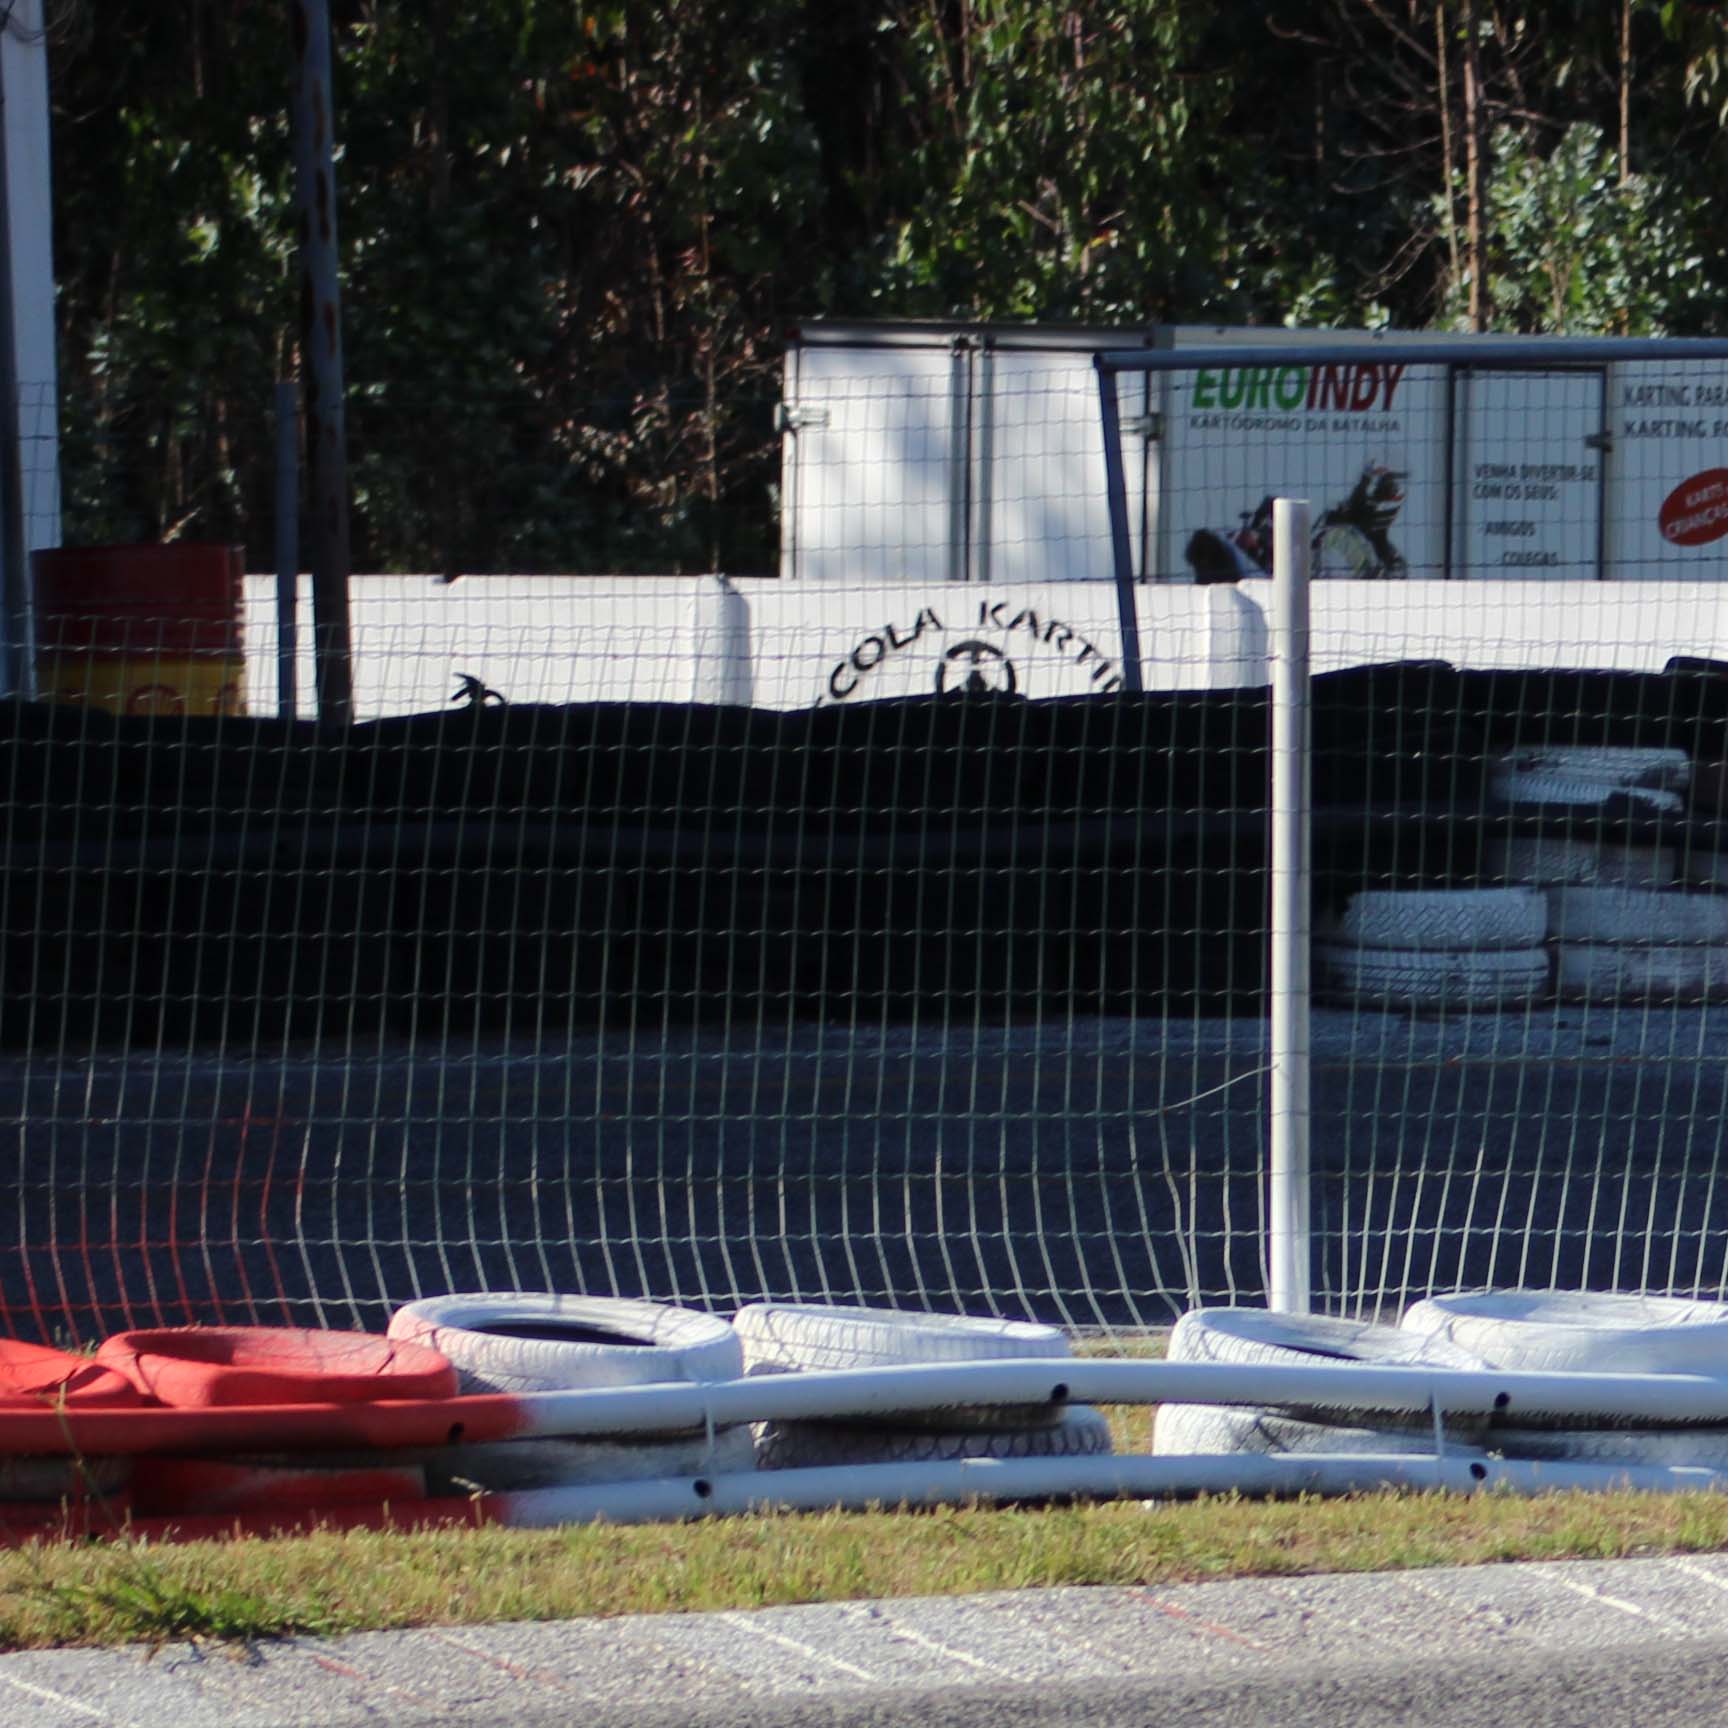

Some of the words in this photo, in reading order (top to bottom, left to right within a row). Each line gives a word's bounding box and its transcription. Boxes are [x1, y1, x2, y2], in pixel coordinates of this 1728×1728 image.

[1192, 363, 1407, 412] EUROINDY
[1624, 385, 1690, 407] KARTING
[1625, 420, 1706, 438] KARTING
[814, 607, 944, 703] COLA
